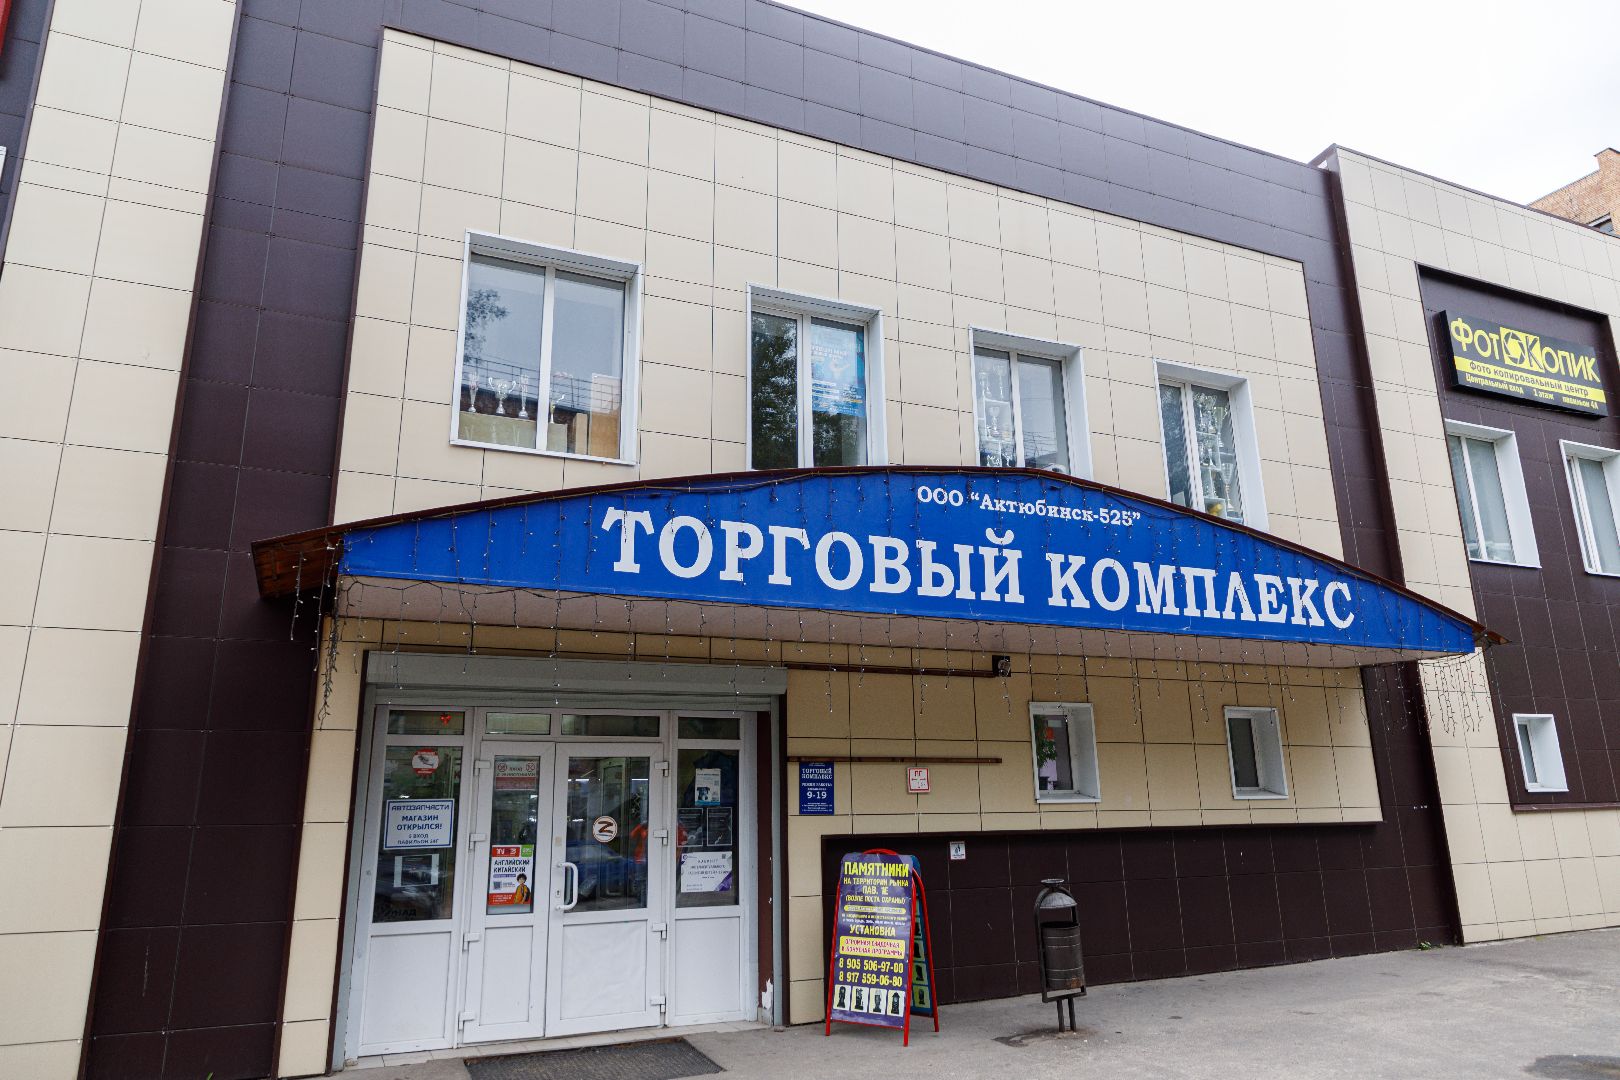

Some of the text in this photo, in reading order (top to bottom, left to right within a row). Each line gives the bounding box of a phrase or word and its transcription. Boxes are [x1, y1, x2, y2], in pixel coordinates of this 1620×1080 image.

[1469, 361, 1491, 375] Фото
[1564, 384, 1589, 398] центр
[917, 485, 964, 507] ООО
[601, 506, 1355, 629] ТОРГОВЫЙ КОМПЛЕКС
[806, 791, 827, 799] 9-19
[401, 814, 439, 822] МАГАЗИН
[396, 823, 443, 831] ОТКРЫЛСЯ!
[494, 858, 530, 866] АНГЛИЙСКИЙ
[494, 865, 526, 873] КИТАЙСКИЙ
[844, 861, 909, 877] ПАМЯТНИКИ
[843, 877, 909, 887] НА ТЕРРИТОРИИ РЫНКА
[862, 886, 878, 895] ПАВ.
[849, 924, 896, 937] УСТАНОВКА
[838, 957, 904, 974] 8 905 506-97-00
[838, 971, 844, 982] 8
[846, 972, 859, 983] 917
